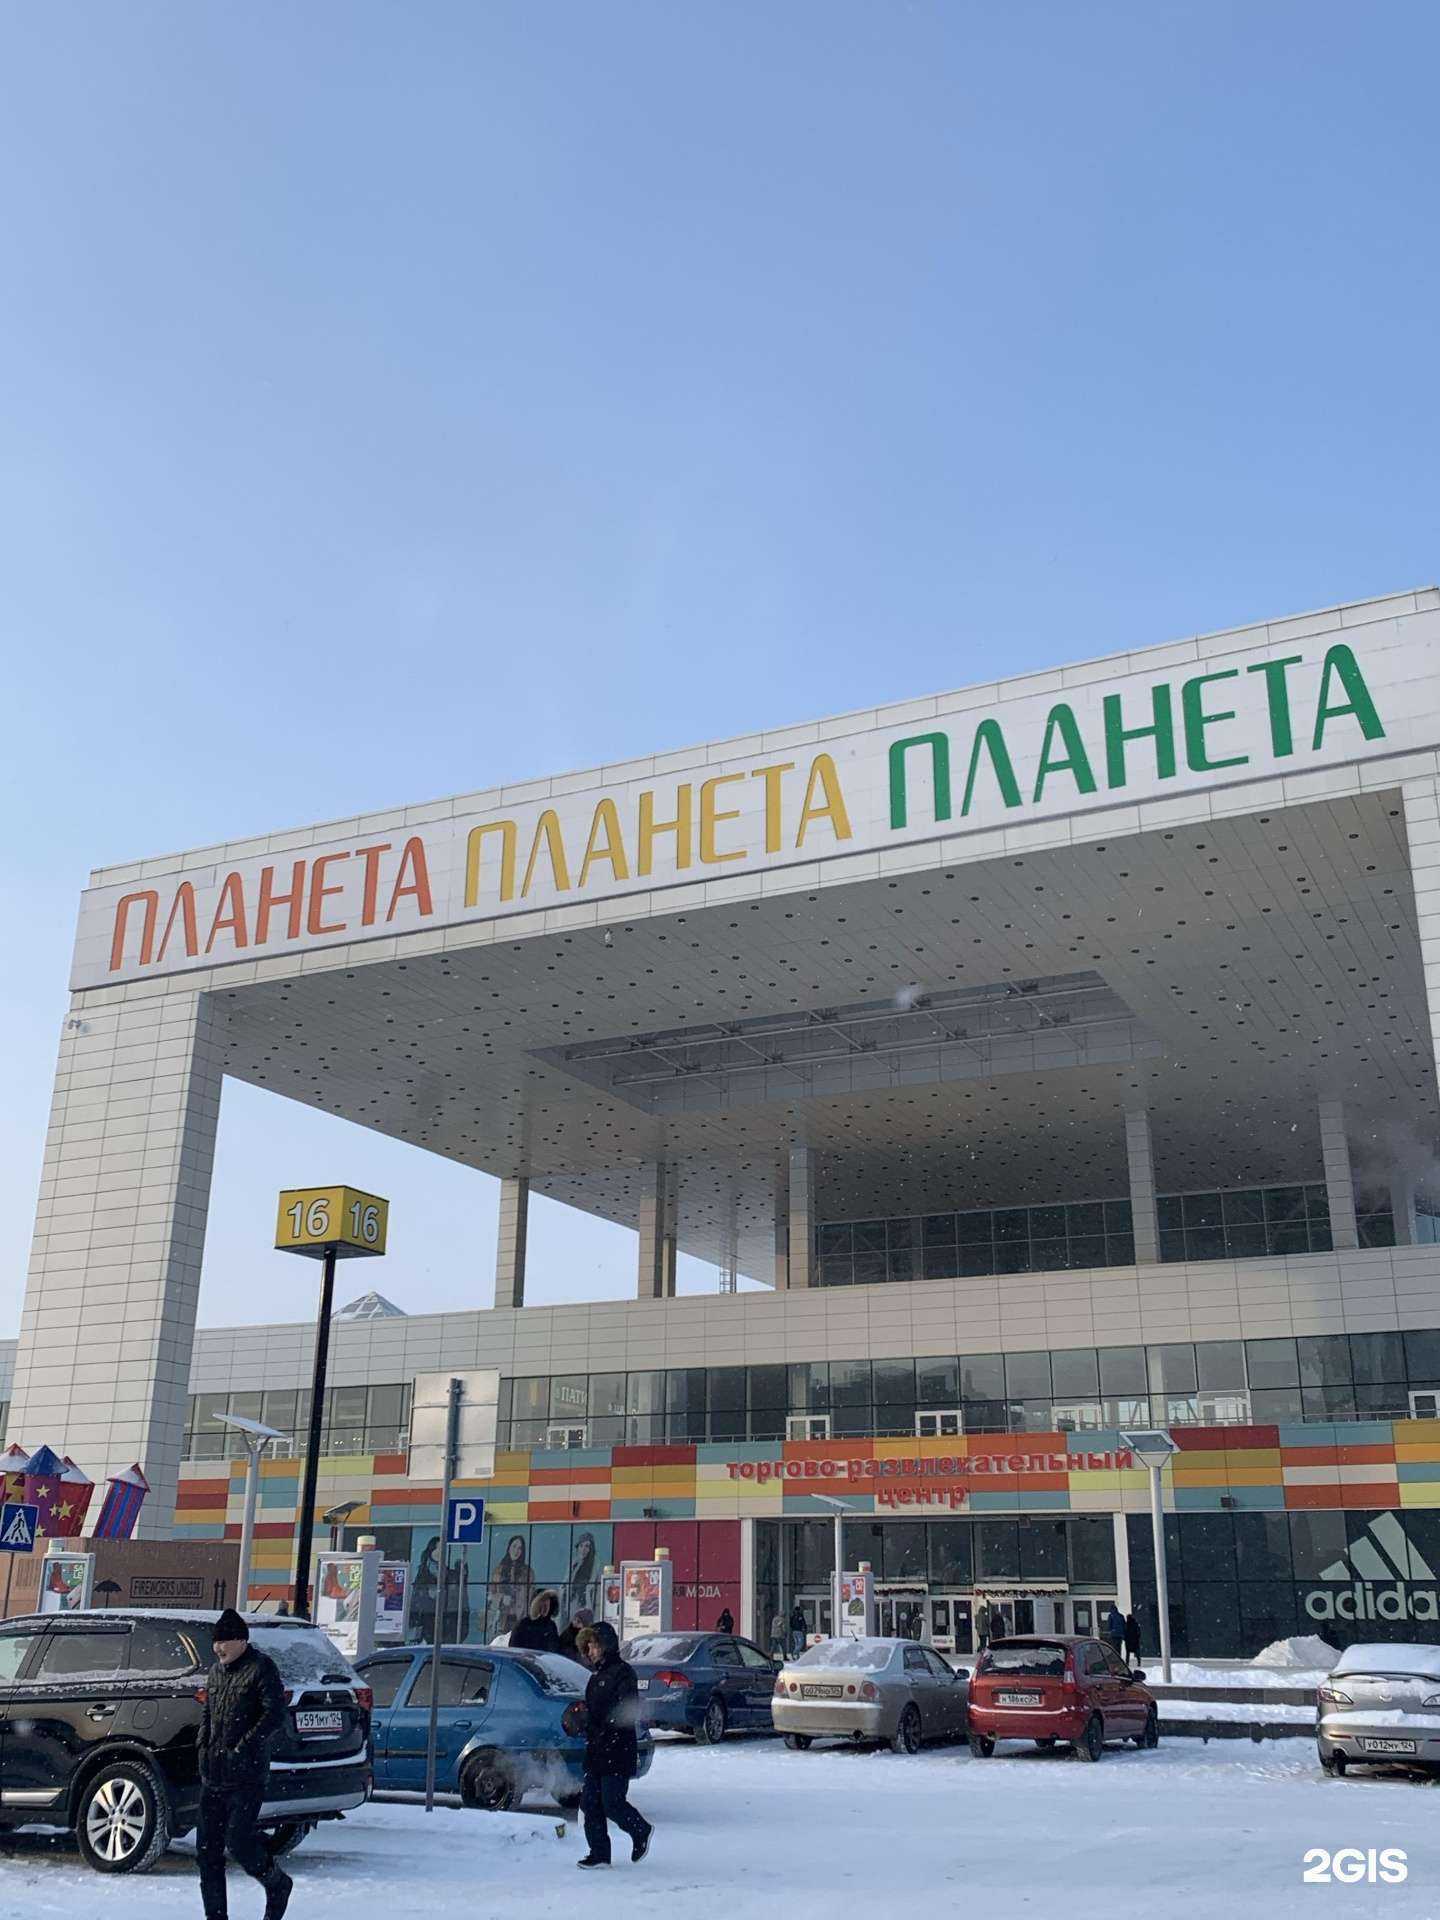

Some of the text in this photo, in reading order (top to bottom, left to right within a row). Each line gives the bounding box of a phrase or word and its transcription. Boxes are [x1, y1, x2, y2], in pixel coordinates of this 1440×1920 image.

[889, 644, 1386, 831] ПЛАНЕТА
[464, 753, 853, 908] ПЛАНЕТА
[109, 836, 433, 972] ПЛАНЕТА
[287, 1198, 330, 1238] 16
[350, 1201, 380, 1243] 16
[726, 1446, 1134, 1483] торгово-развлекательный
[877, 1485, 969, 1509] центр
[453, 1502, 477, 1539] P
[685, 1584, 721, 1598] МОДА
[1305, 1582, 1440, 1620] adida
